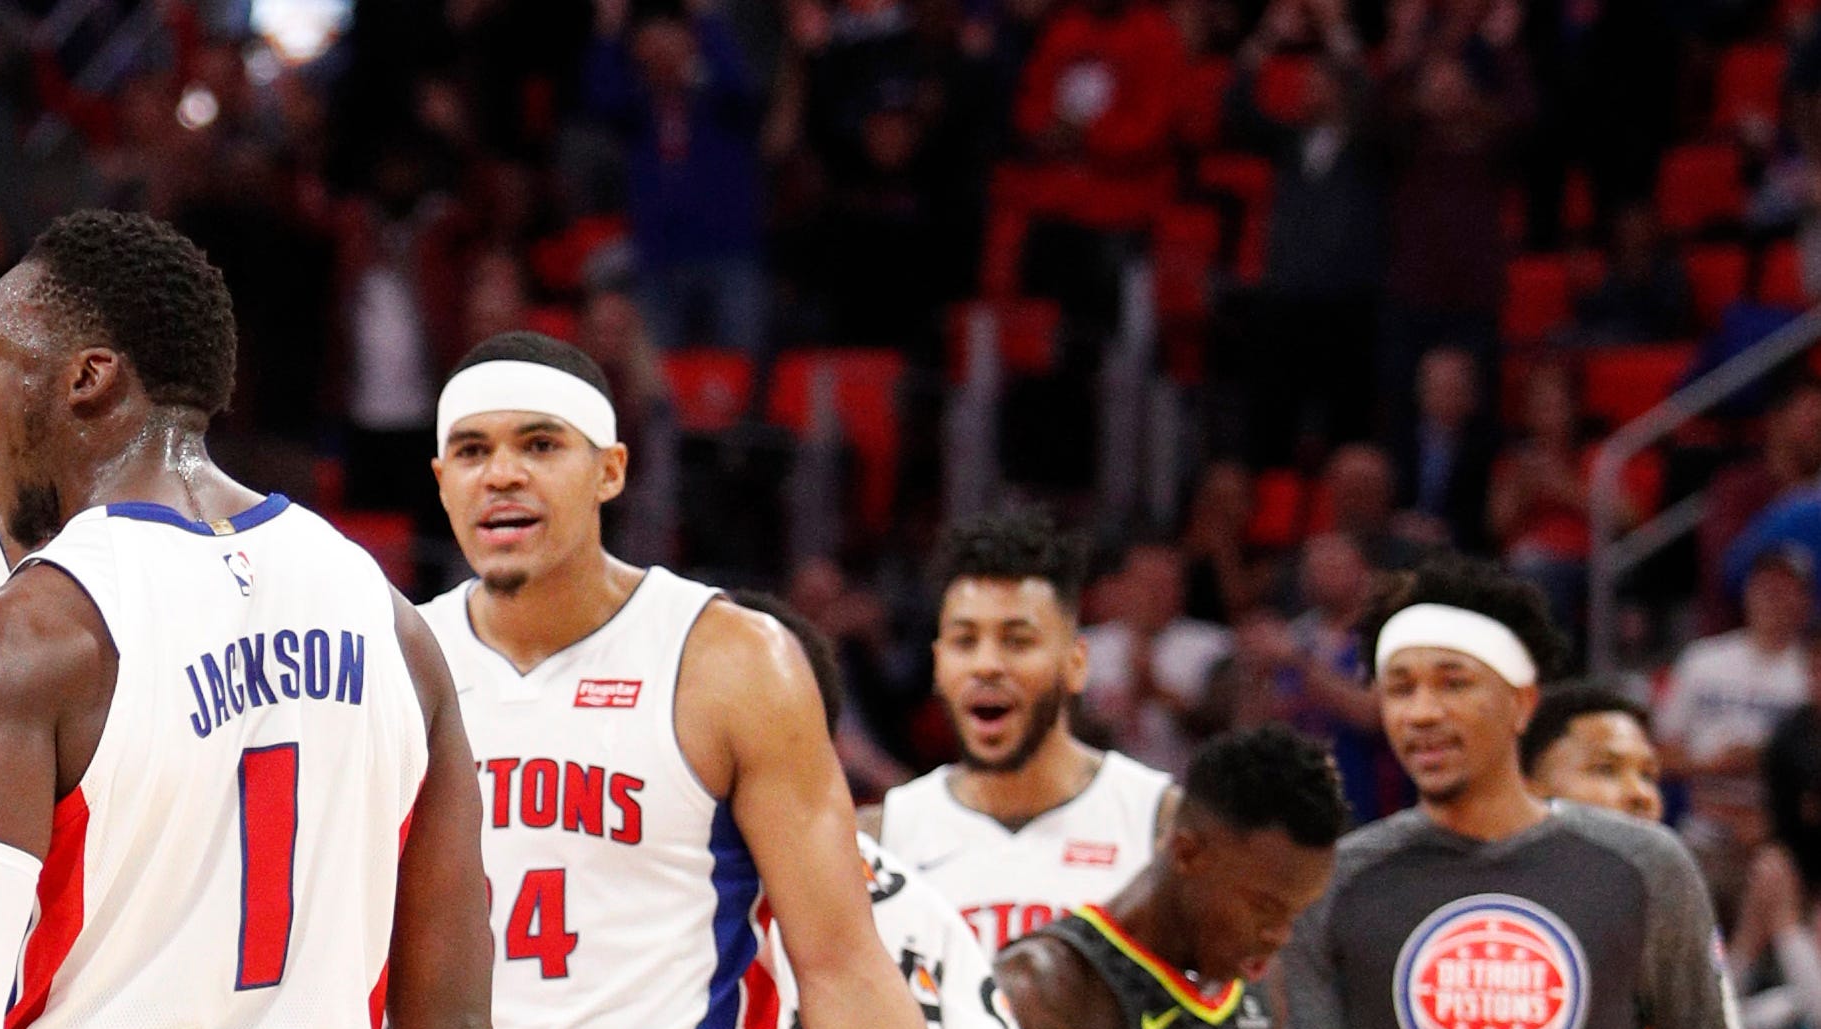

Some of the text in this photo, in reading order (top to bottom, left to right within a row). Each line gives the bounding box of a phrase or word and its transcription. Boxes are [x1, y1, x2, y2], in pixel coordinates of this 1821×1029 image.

[184, 628, 364, 739] JACKSON
[476, 757, 645, 846] TONS
[234, 741, 299, 992] 1
[1434, 991, 1548, 1024] PISTONS
[1436, 958, 1546, 988] DETROIT
